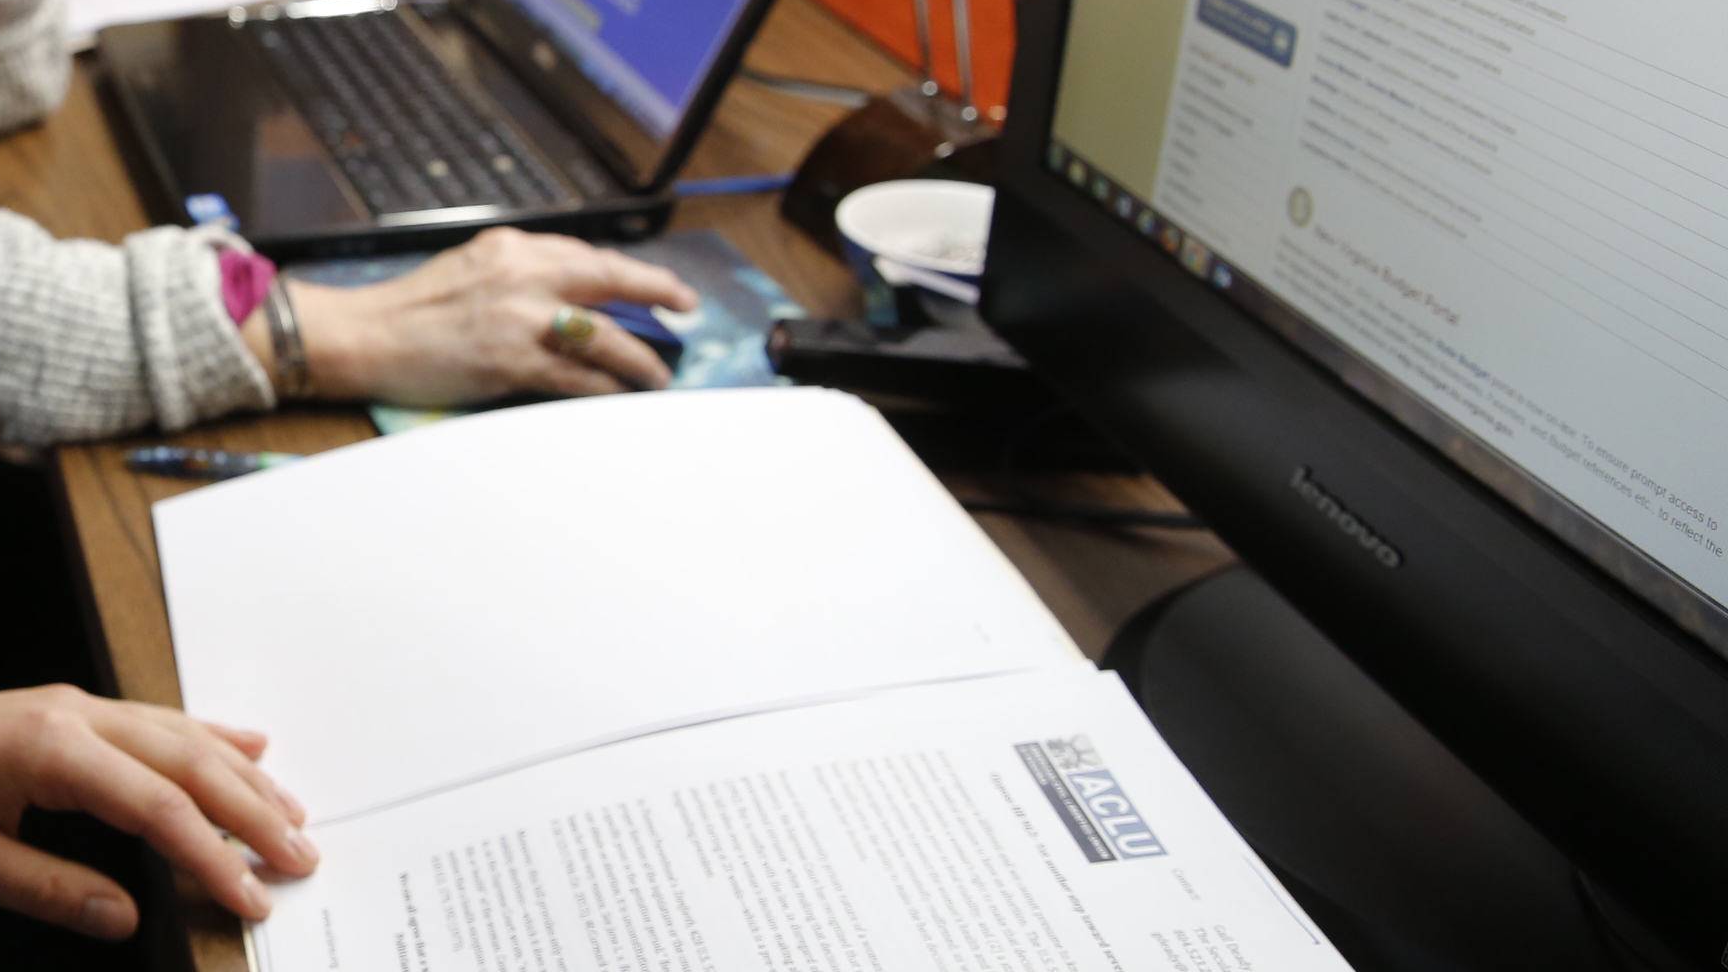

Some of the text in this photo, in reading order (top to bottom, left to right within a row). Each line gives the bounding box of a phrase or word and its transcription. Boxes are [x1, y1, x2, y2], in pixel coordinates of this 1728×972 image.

[1290, 465, 1403, 567] lenovo
[1582, 434, 1595, 451] To
[1596, 446, 1629, 473] ensure
[1630, 469, 1667, 498] prompt
[1668, 494, 1704, 523] access
[1707, 517, 1717, 531] to
[1583, 458, 1633, 498] references
[1658, 507, 1669, 521] to
[1671, 518, 1703, 545] reflect
[1705, 539, 1722, 557] the
[1071, 776, 1160, 861] ACLU
[1193, 927, 1210, 944] The
[1213, 925, 1234, 942] Gail
